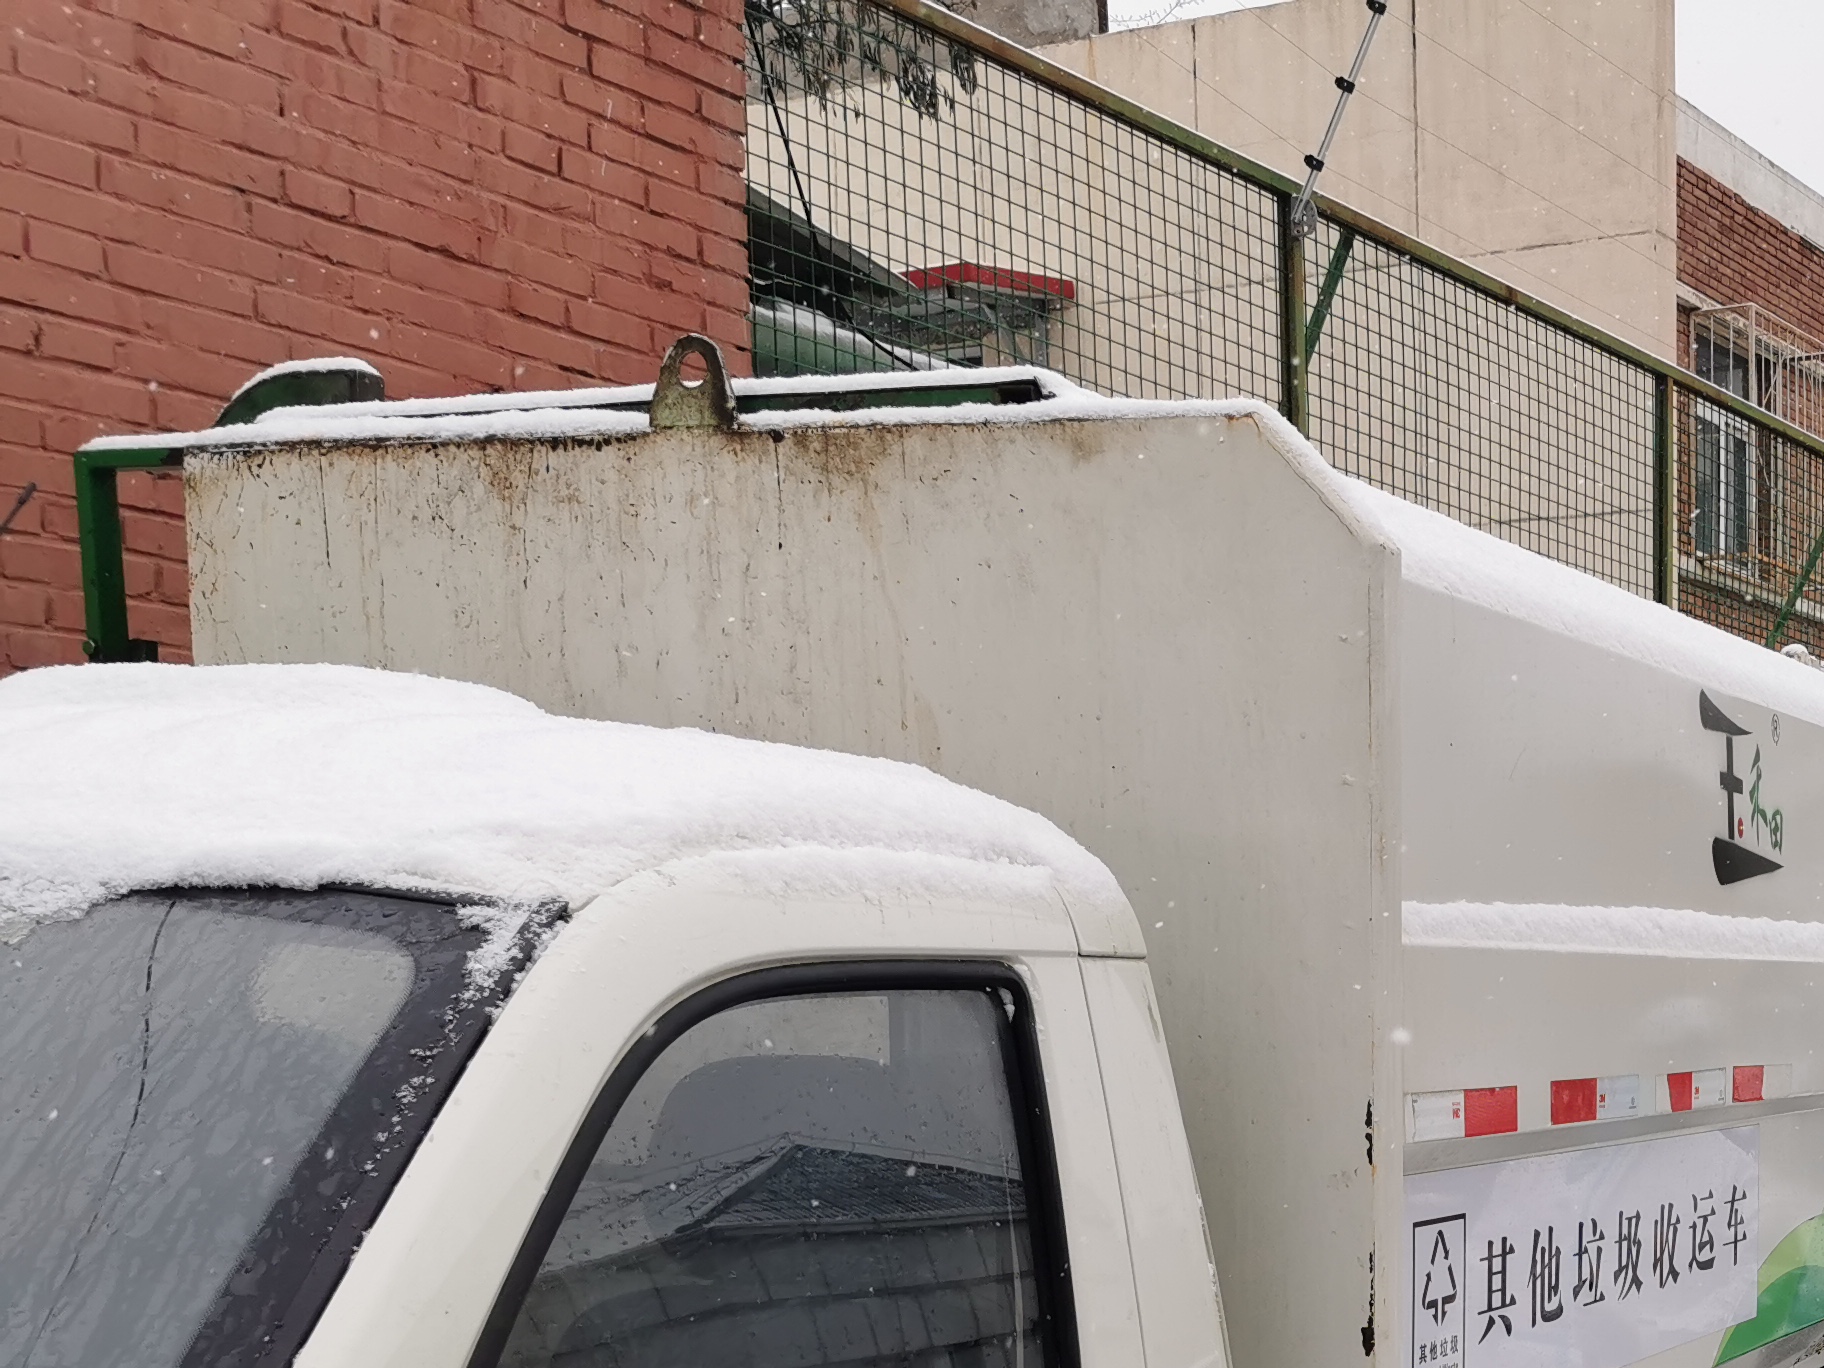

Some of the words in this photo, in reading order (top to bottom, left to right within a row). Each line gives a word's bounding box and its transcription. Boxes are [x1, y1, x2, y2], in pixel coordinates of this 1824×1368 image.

[1477, 1184, 1747, 1345] 其他垃圾收运车
[1419, 1335, 1459, 1365] 其他垃圾
